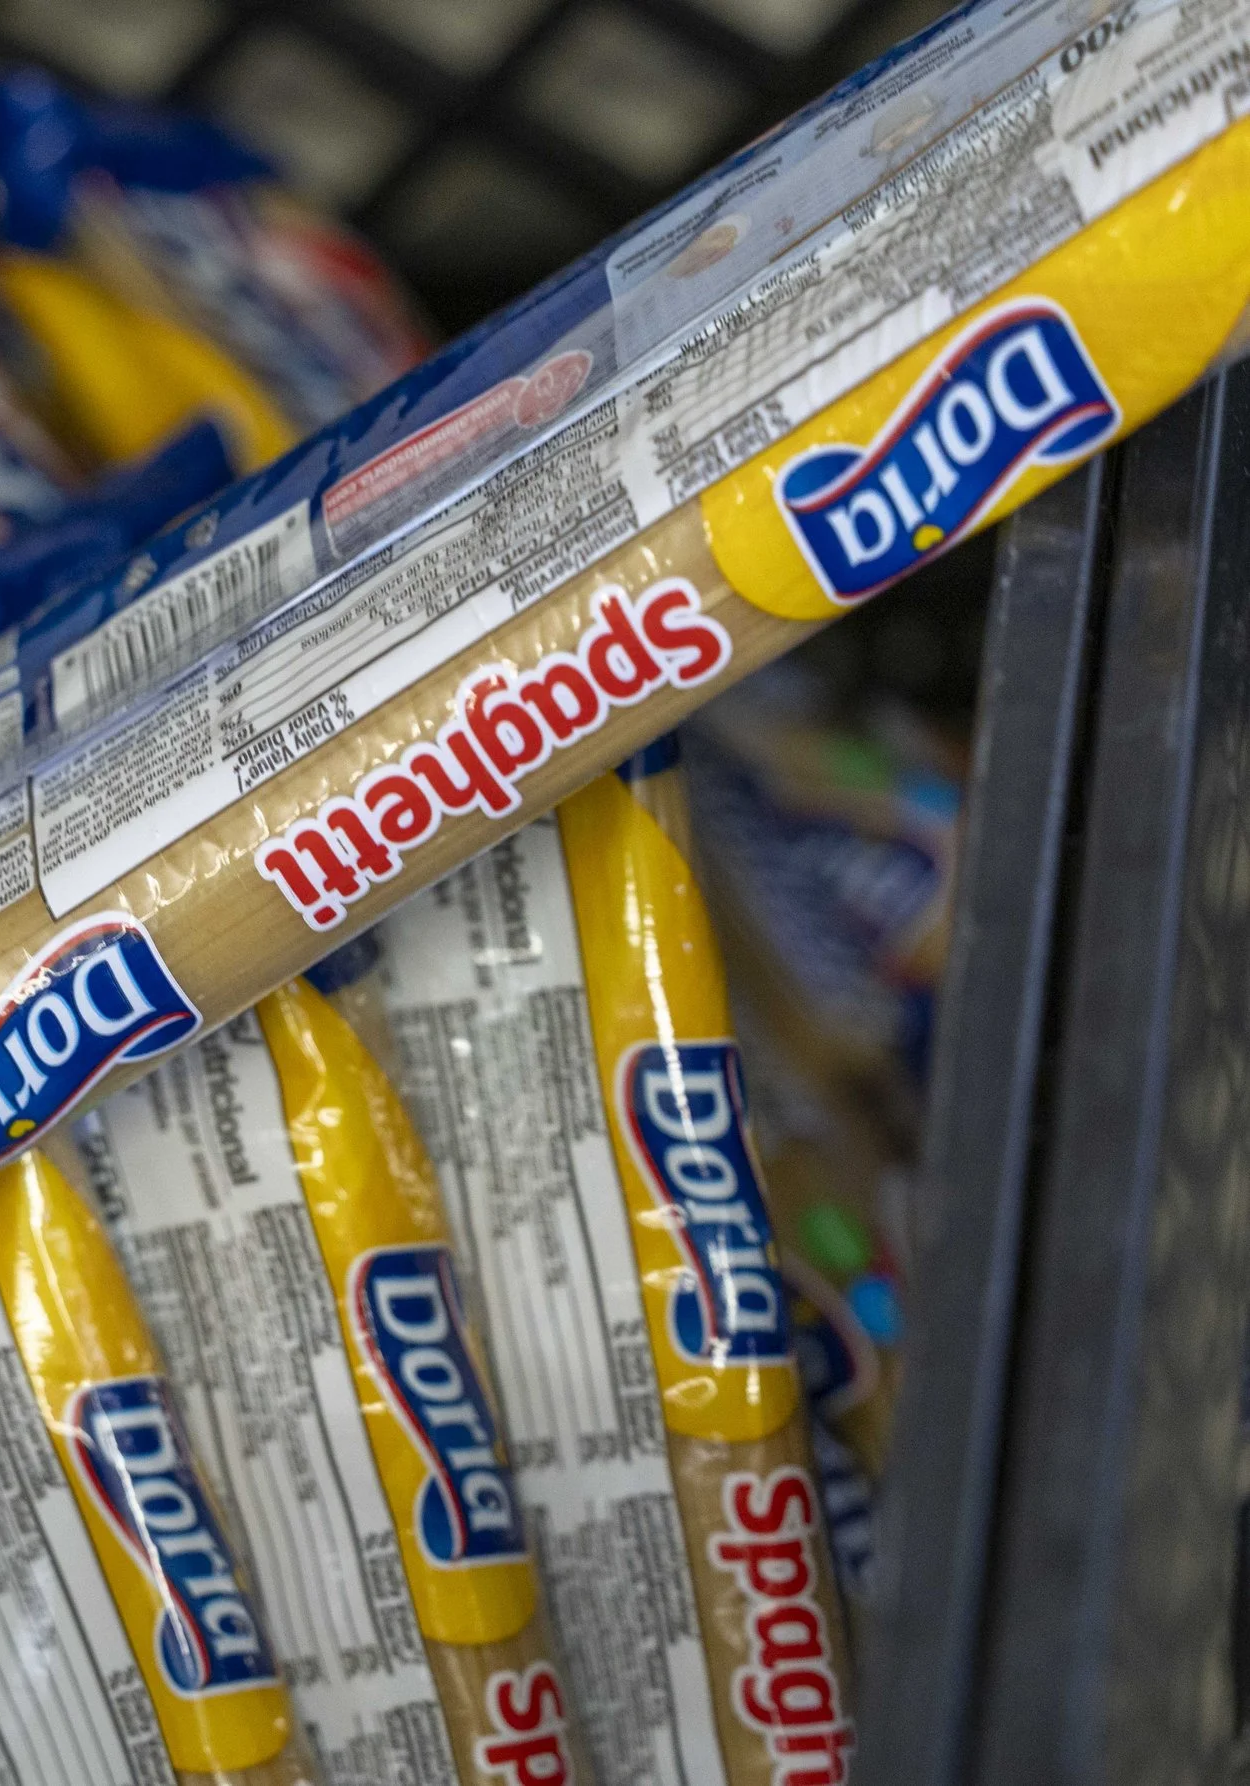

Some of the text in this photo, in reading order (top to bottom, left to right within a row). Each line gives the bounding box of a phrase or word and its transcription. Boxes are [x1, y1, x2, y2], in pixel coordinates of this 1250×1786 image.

[825, 328, 1075, 568] Doria
[267, 593, 718, 922] Spaghetti
[288, 700, 325, 738] Valor
[295, 713, 332, 755] Daily
[644, 1068, 778, 1336] Doria
[374, 1274, 512, 1534] Doria
[95, 1406, 260, 1660] Doria
[720, 1473, 852, 1786] Spagh
